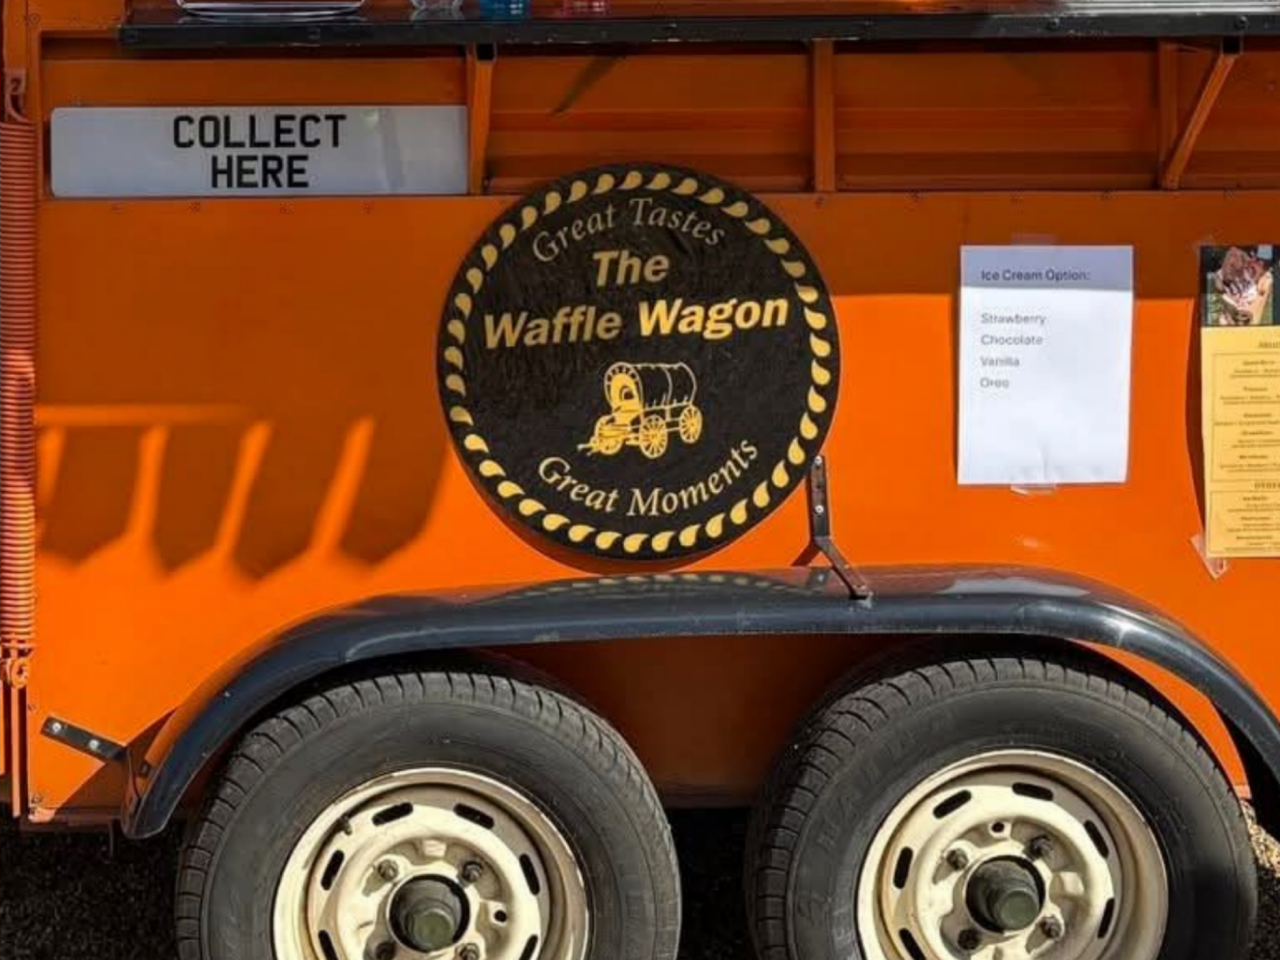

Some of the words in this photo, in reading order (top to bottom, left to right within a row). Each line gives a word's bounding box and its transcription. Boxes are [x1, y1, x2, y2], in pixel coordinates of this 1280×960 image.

[173, 114, 347, 149] COLLECT
[210, 154, 309, 189] HERE
[532, 203, 618, 263] Great
[629, 196, 726, 247] Tastes
[592, 249, 670, 288] The
[981, 270, 1000, 281] Ice
[1002, 269, 1043, 281] Cream
[483, 305, 622, 349] Waffle
[639, 298, 789, 339] Wagon
[980, 312, 1047, 327] Strawberry
[980, 334, 1044, 346] Chocolate
[980, 356, 1020, 367] Vanilla
[538, 456, 620, 514] Great
[626, 438, 760, 517] Moments
